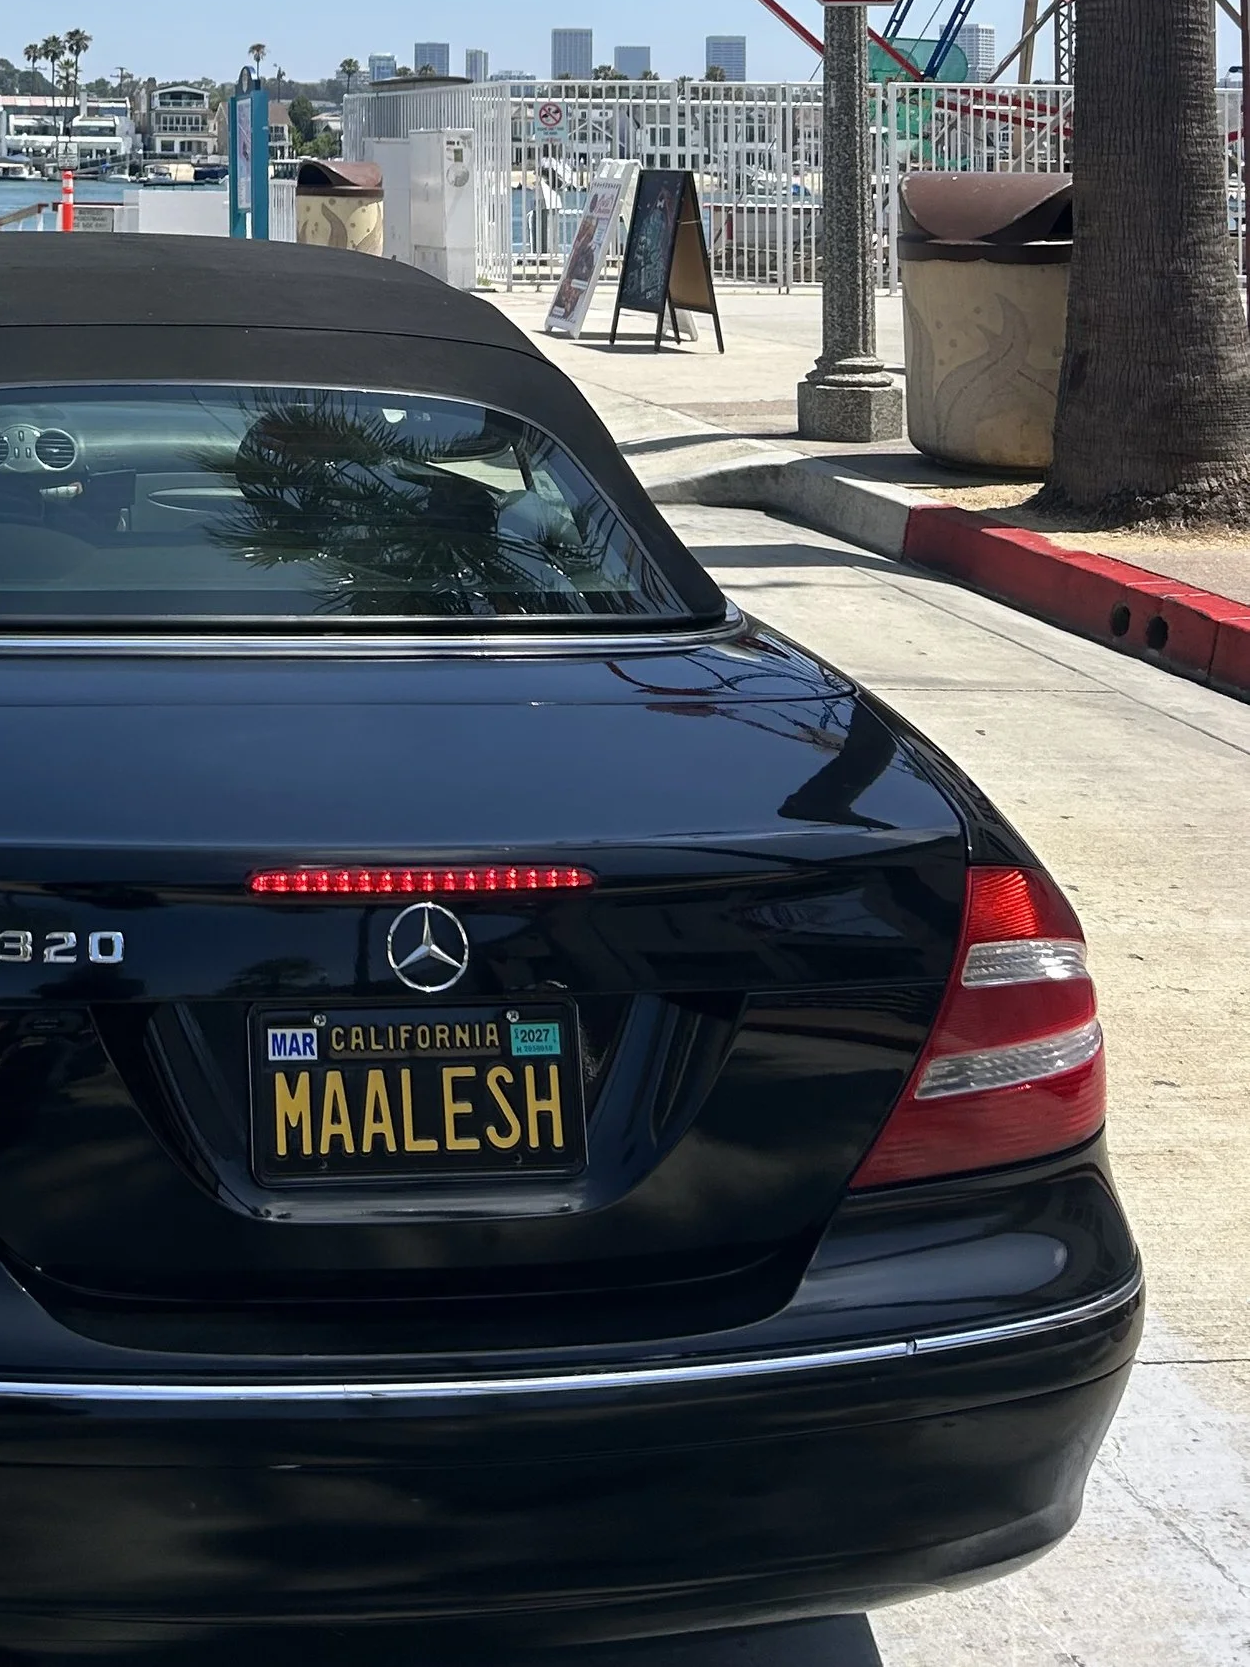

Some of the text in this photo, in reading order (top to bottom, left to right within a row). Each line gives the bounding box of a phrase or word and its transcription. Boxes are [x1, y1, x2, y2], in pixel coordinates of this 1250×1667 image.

[271, 1032, 316, 1057] MAR
[330, 1023, 500, 1051] CALIFORNIA
[520, 1028, 550, 1043] 2027
[274, 1064, 564, 1156] MAALESH
